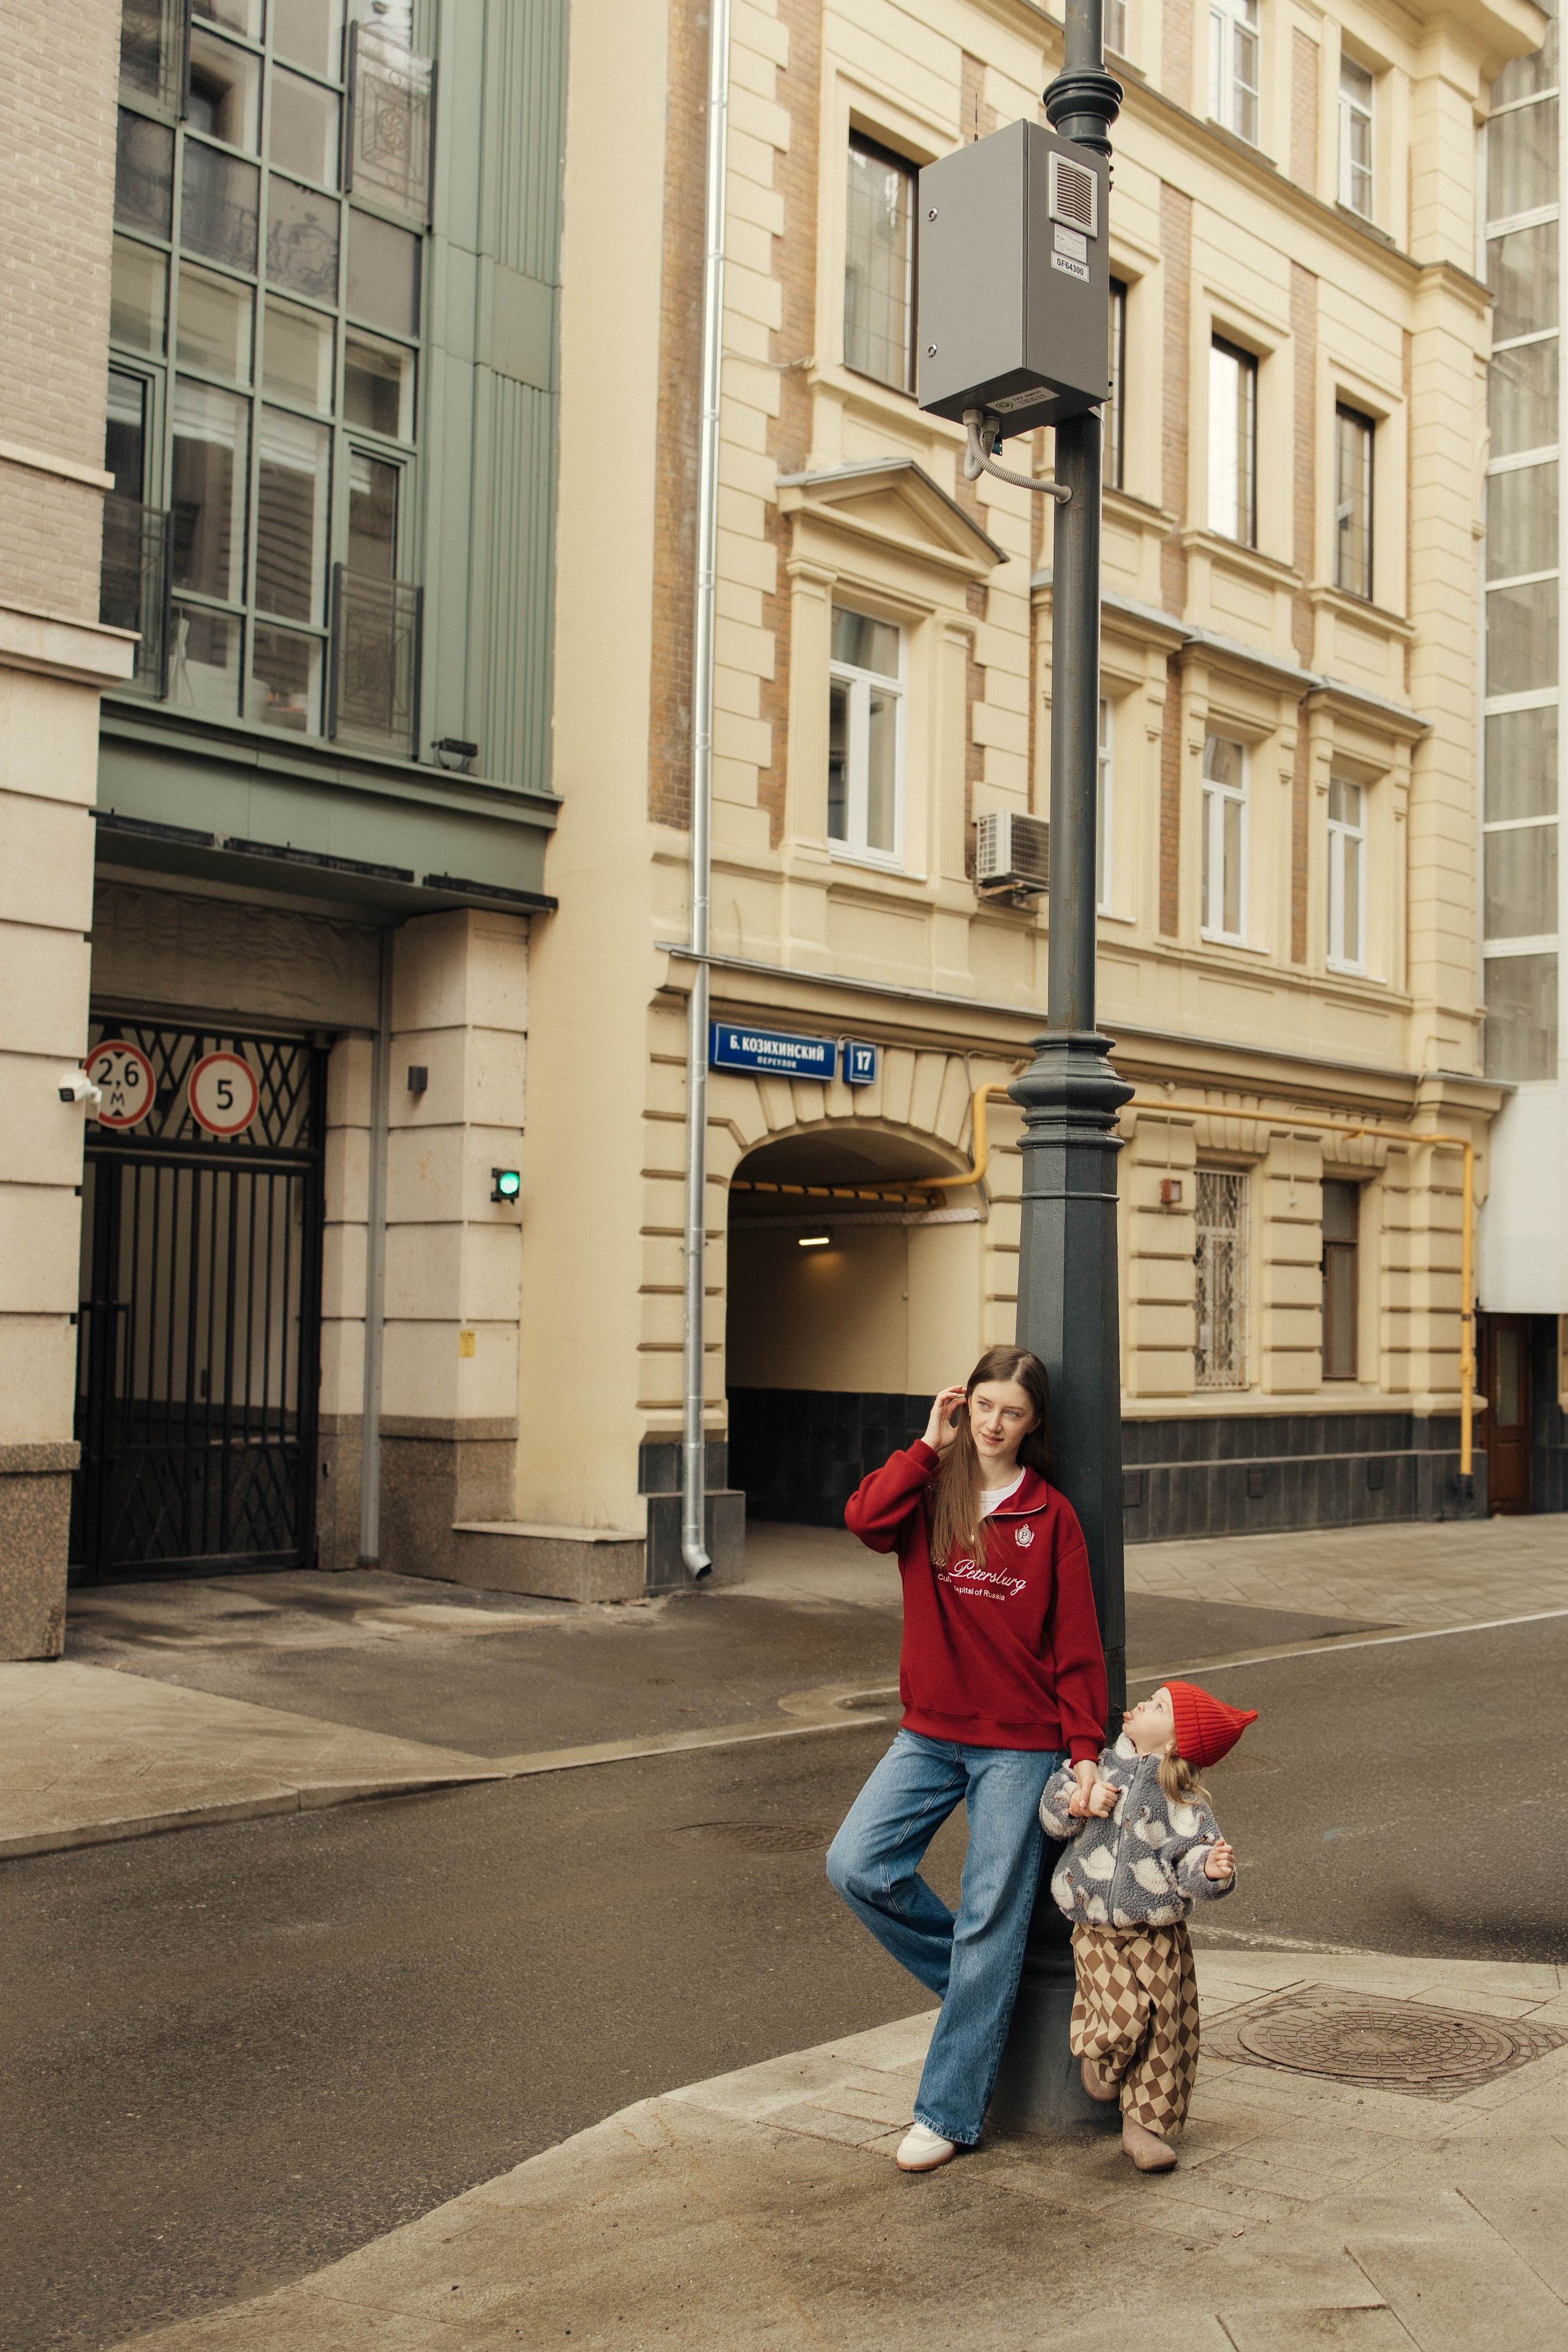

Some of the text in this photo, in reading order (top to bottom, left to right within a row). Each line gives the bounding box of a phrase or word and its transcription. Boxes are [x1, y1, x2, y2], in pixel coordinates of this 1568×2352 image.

[1057, 258, 1084, 275] SF64300
[730, 1035, 824, 1062] Б. КОЗИХИНСКИЙ
[856, 1050, 872, 1071] 17
[97, 1058, 139, 1089] 2,6
[757, 1055, 797, 1069] ПЕРЕУЛОК
[216, 1080, 233, 1109] 5
[948, 1559, 1027, 1596] Petersburg
[983, 1589, 1005, 1601] Russia
